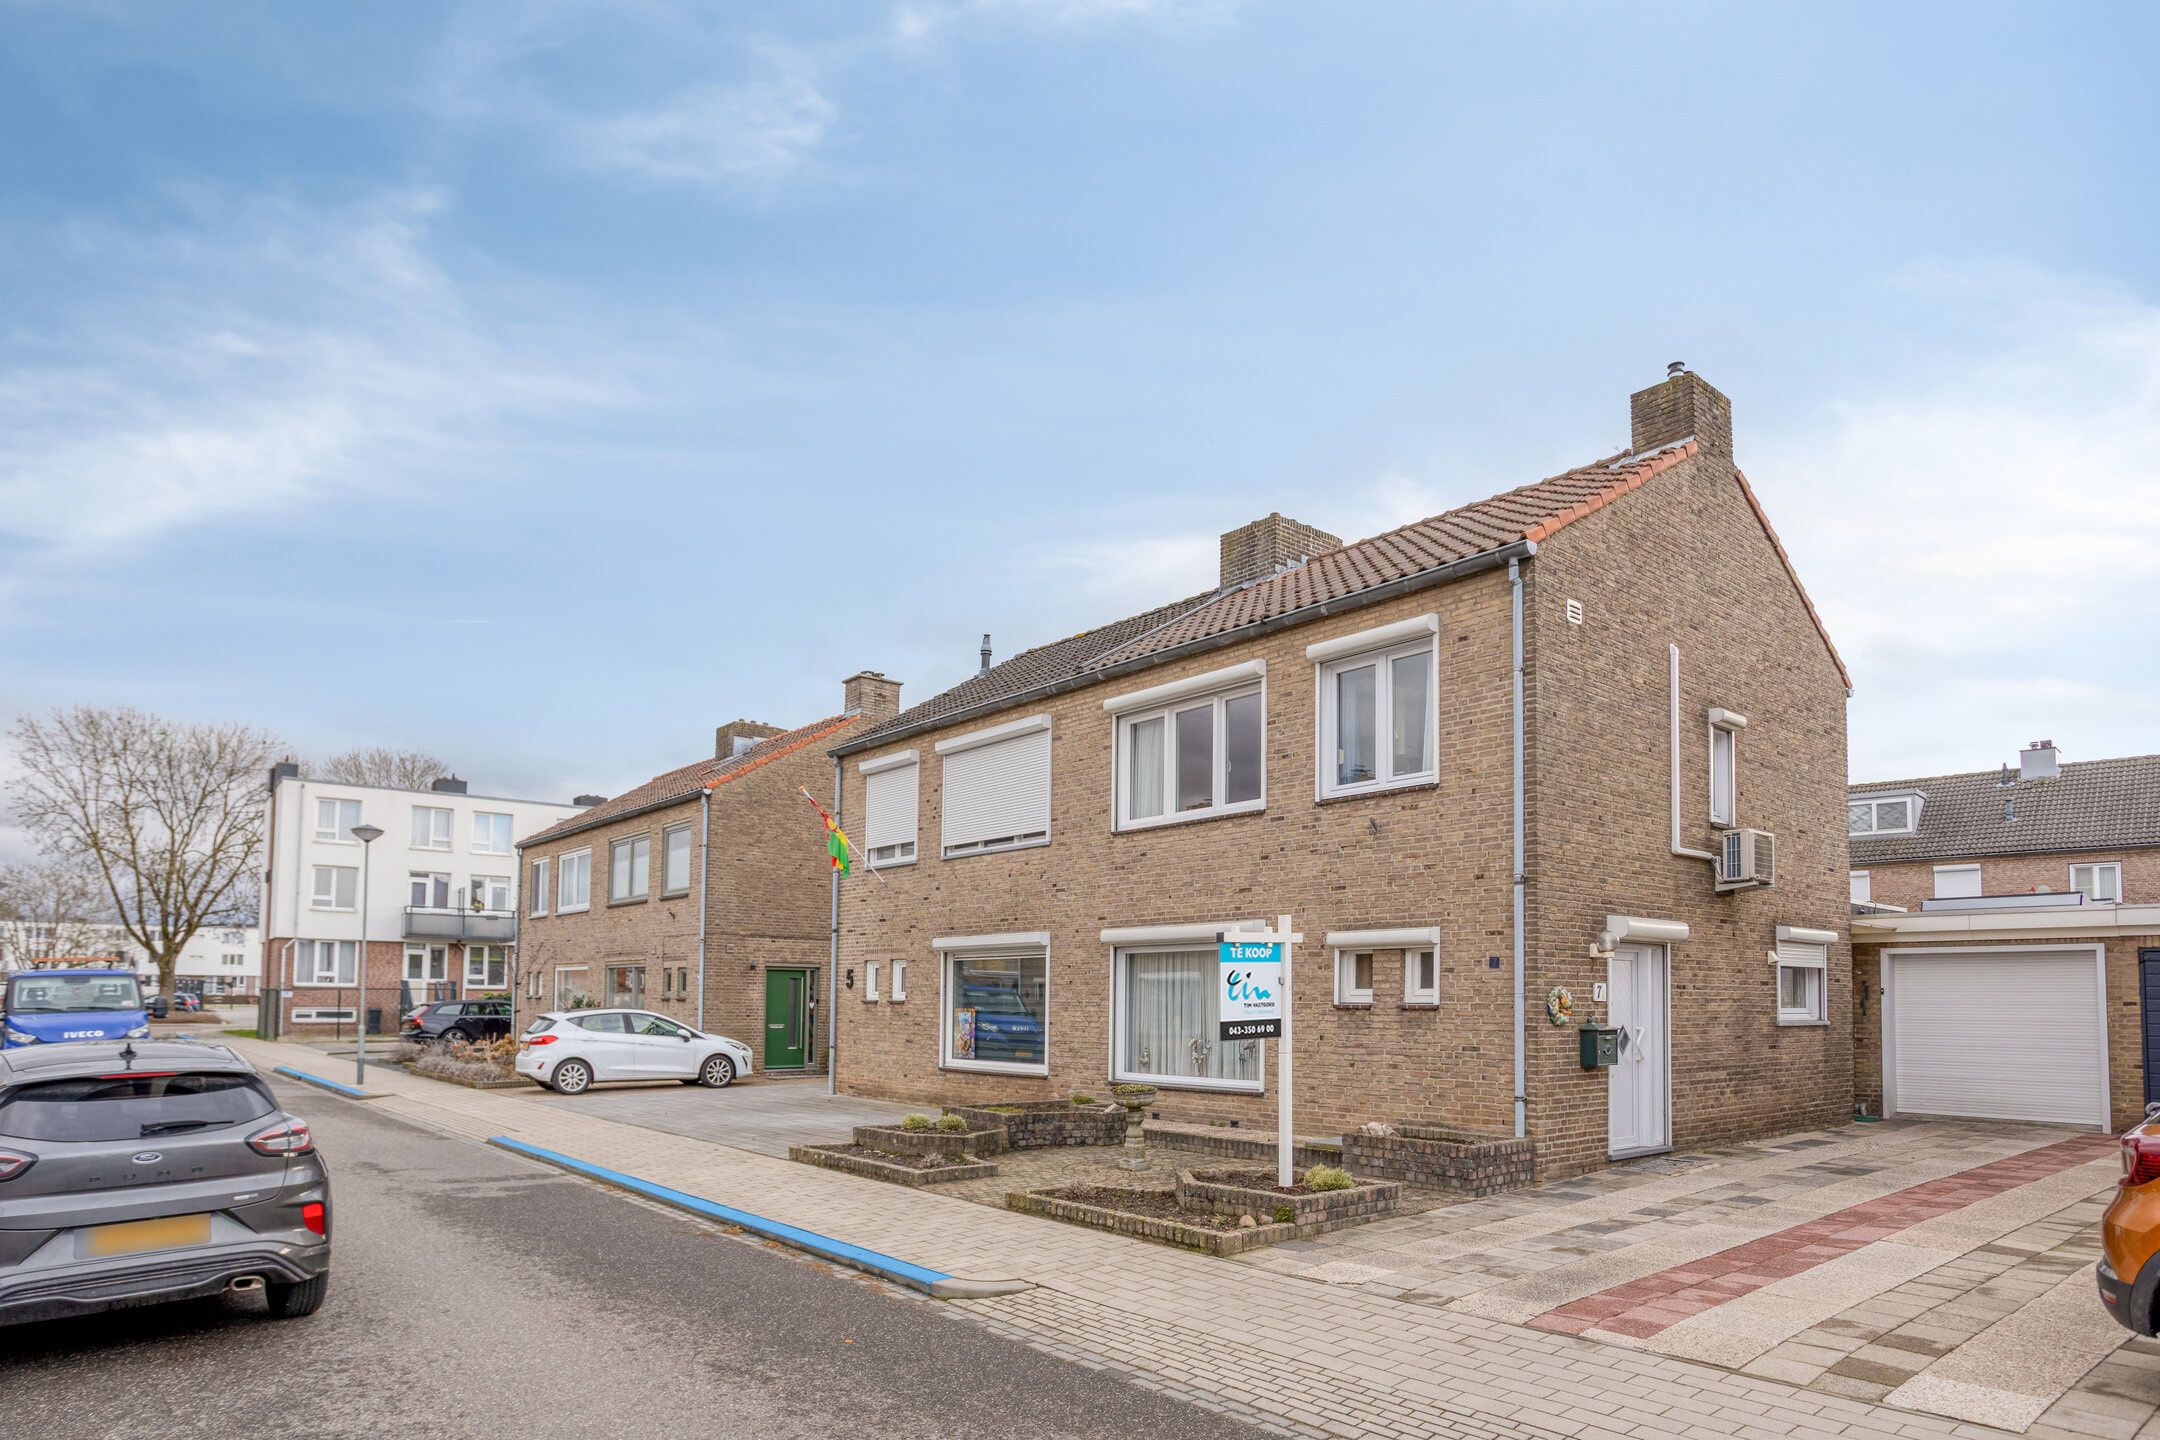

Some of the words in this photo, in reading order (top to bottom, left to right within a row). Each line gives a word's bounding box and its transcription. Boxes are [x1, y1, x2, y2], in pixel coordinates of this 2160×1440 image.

[1230, 947, 1242, 958] TE
[1245, 947, 1272, 958] KOOP
[846, 969, 853, 989] 5
[1596, 985, 1602, 999] 7
[63, 1030, 104, 1039] IVECO
[1229, 1025, 1256, 1035] 043-350
[1257, 1025, 1265, 1033] 69
[1266, 1024, 1274, 1033] 00
